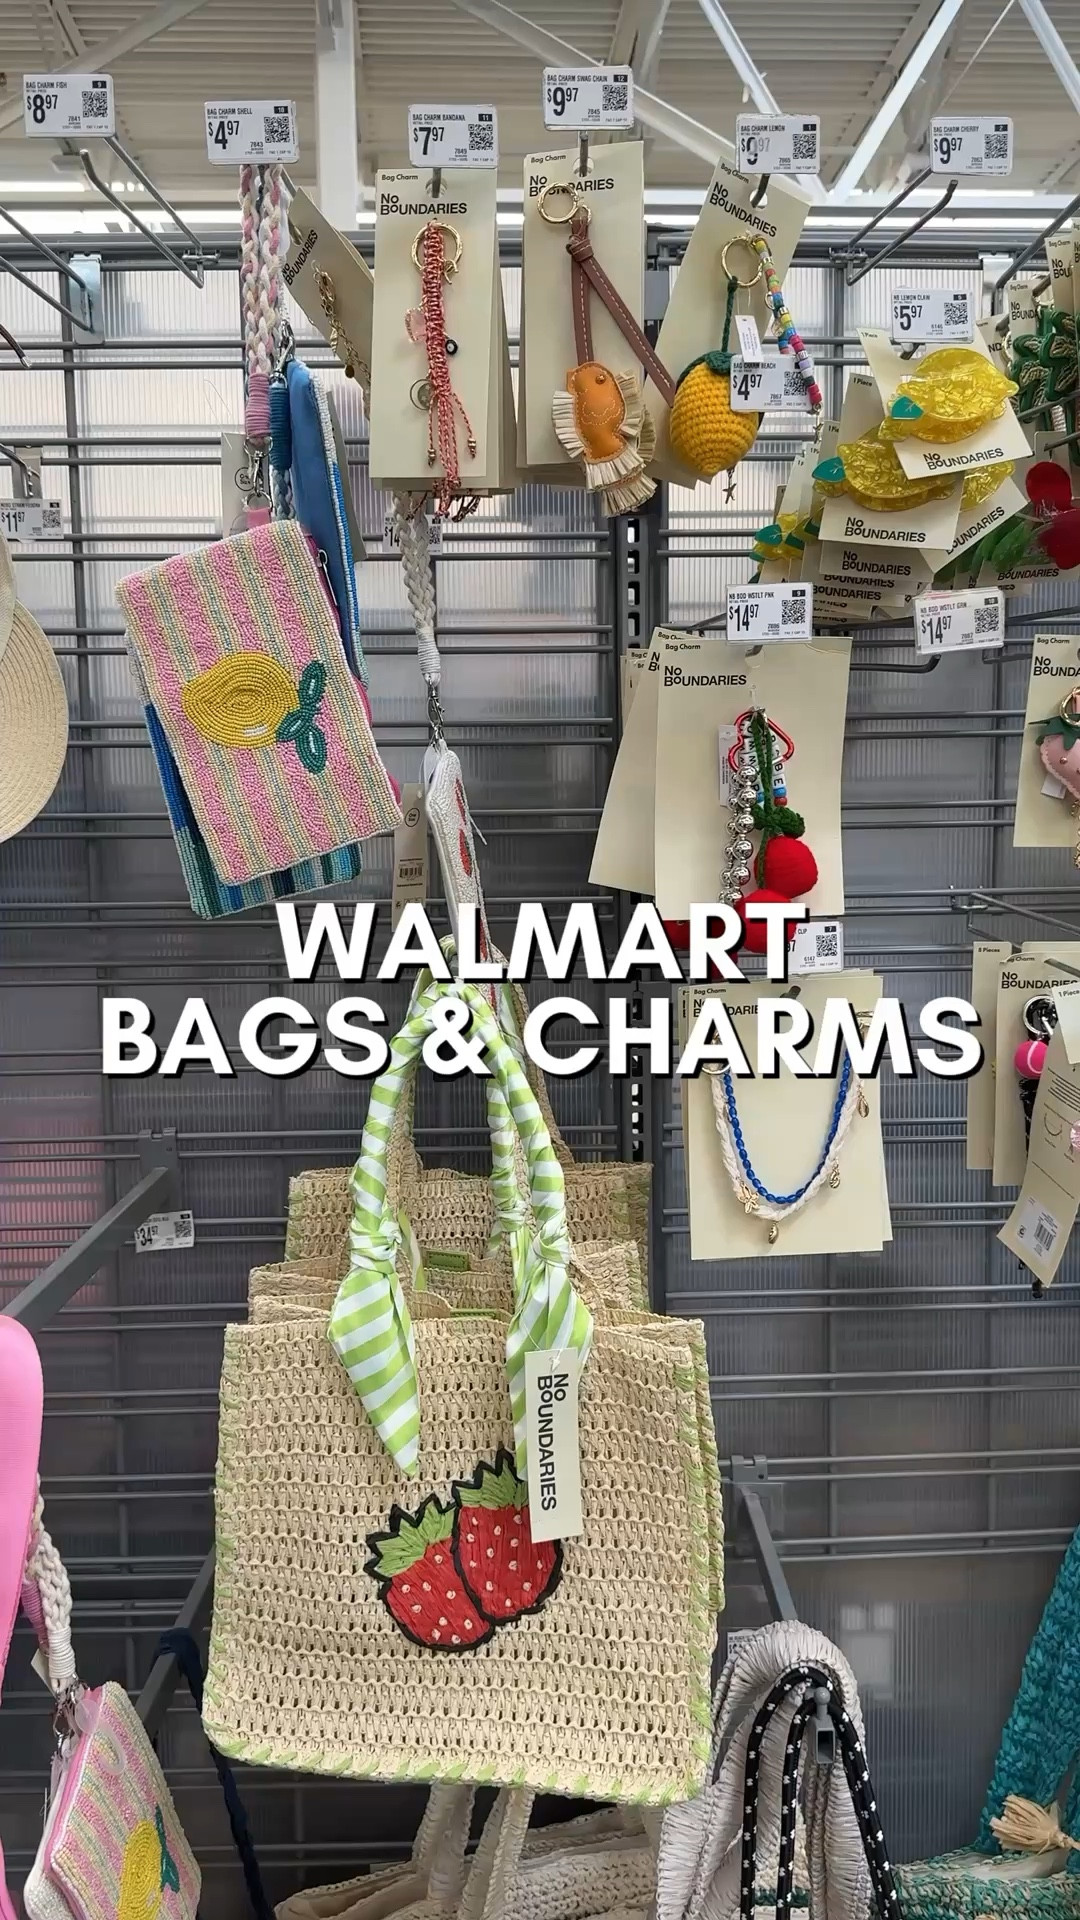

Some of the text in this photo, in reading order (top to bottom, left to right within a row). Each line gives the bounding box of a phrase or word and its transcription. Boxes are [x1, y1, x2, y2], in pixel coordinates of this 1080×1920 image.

[720, 163, 749, 184] Bag Charm
[380, 203, 467, 215] BOUNDARIES
[710, 193, 777, 237] BOUNDARIES
[284, 229, 318, 286] BOUNDARIES
[1012, 310, 1038, 320] BOUNDA
[927, 448, 1004, 470] BOUNDARIES
[845, 527, 926, 543] BOUNDARIES
[842, 561, 911, 576] BOUNDARIES
[998, 568, 1060, 581] BOUNDARIES
[1033, 666, 1080, 677] BOUNDA
[664, 675, 747, 686] BOUNDARIES
[537, 1376, 557, 1511] BOUNDARIES
